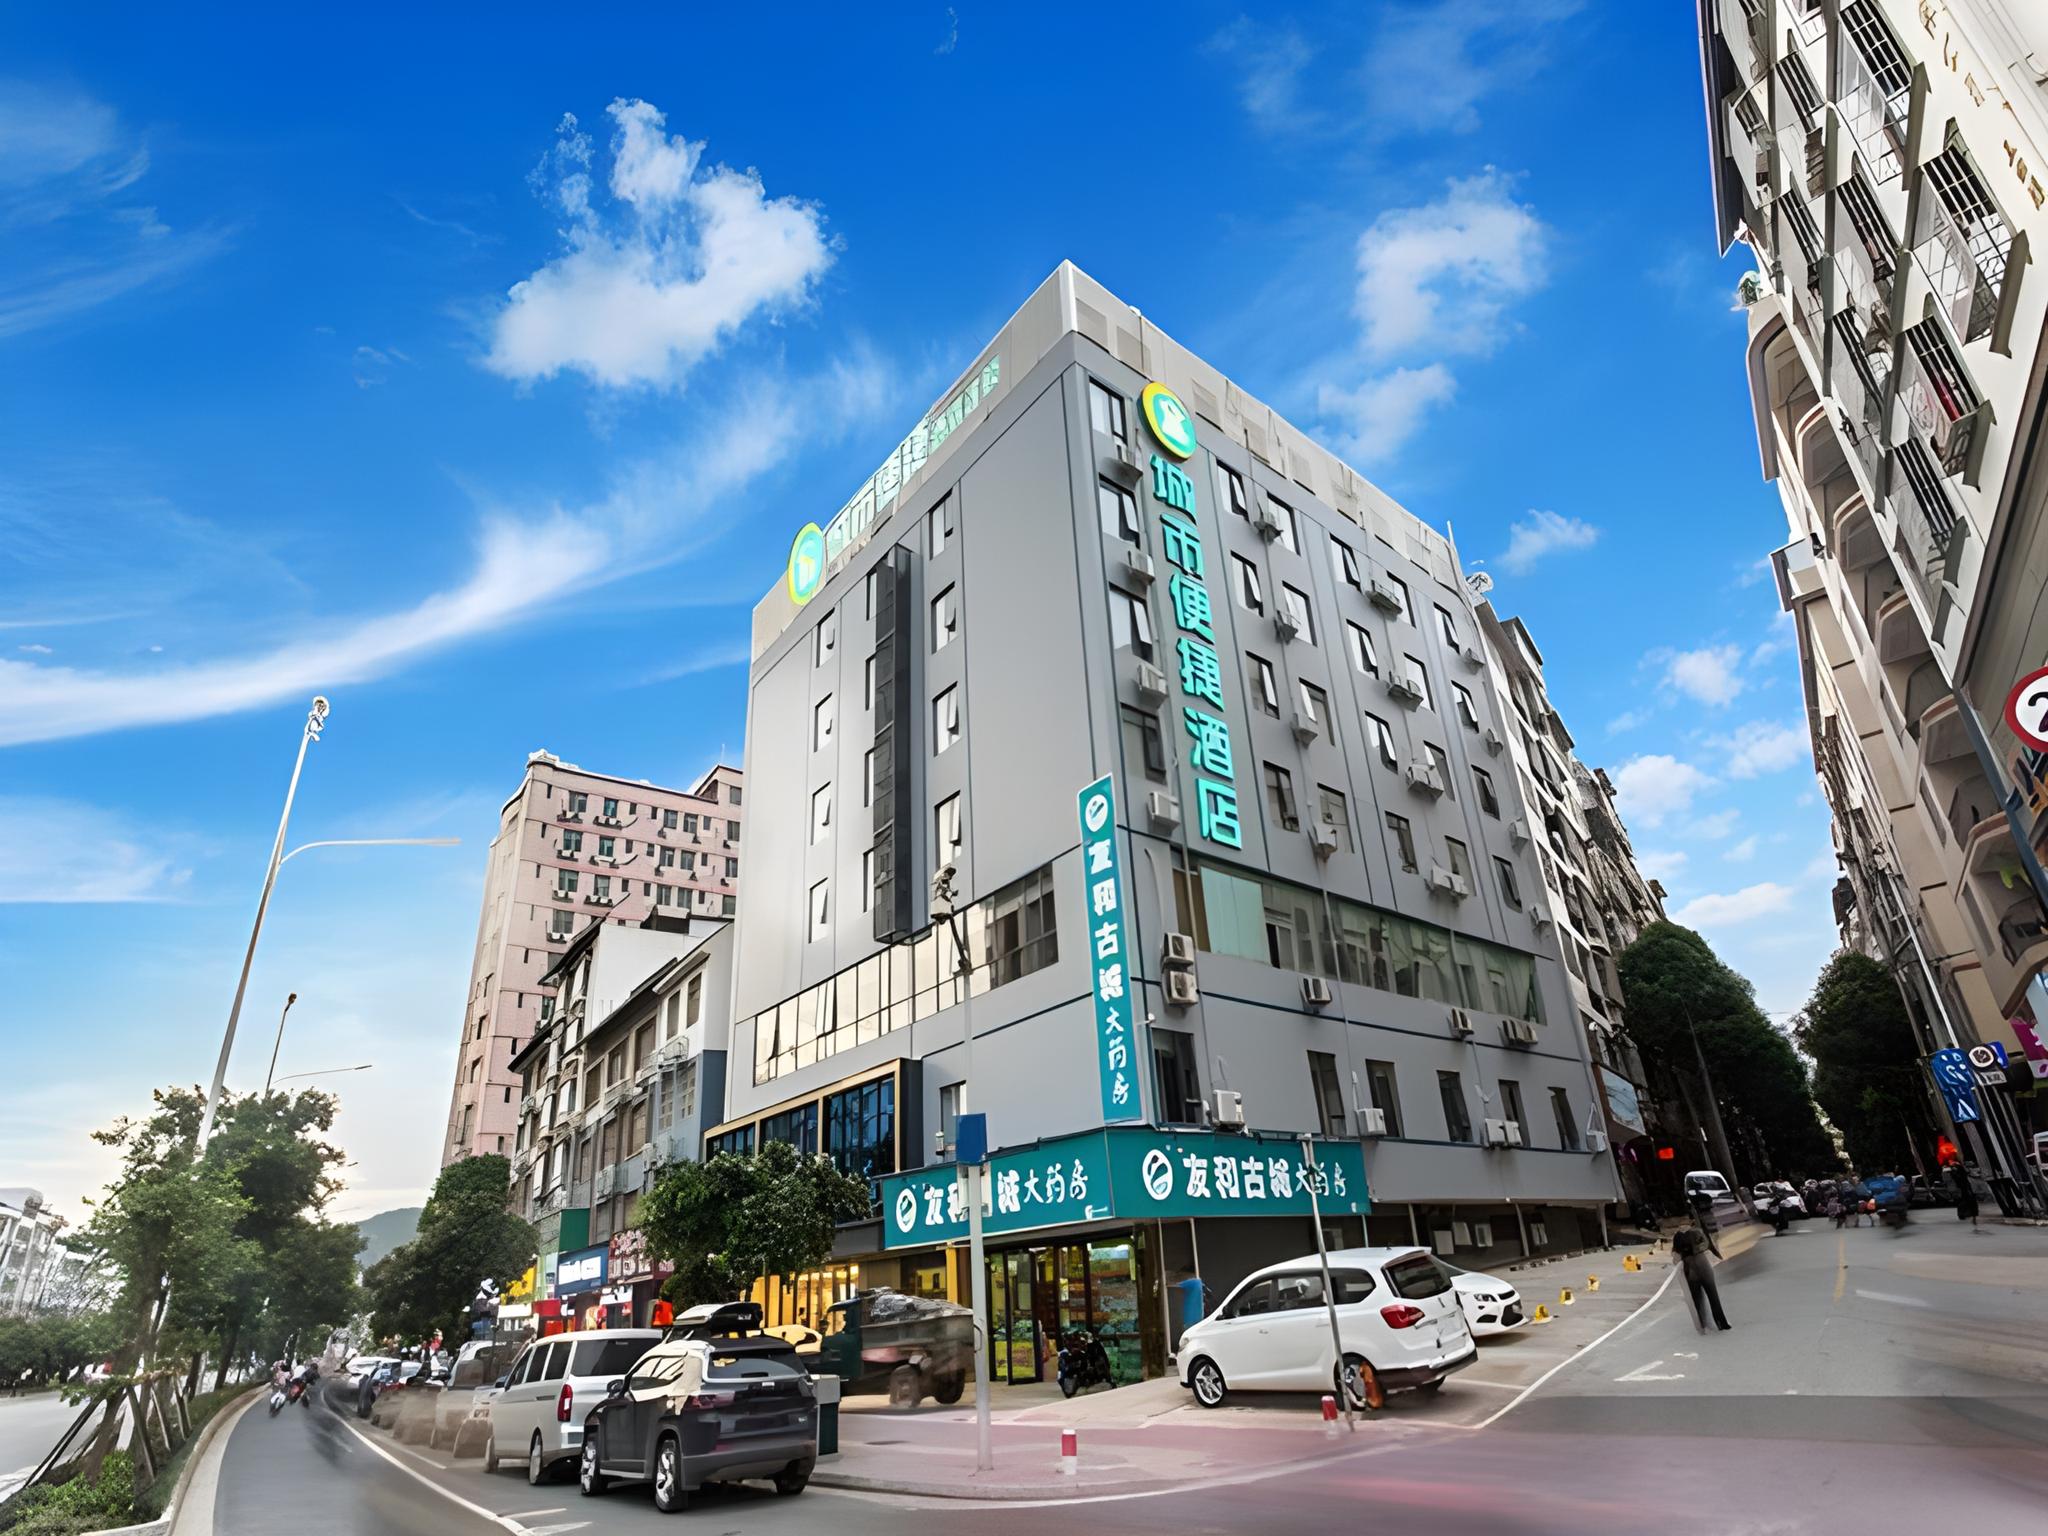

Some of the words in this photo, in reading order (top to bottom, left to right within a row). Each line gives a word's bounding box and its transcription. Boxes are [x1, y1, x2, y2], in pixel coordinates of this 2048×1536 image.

[1150, 453, 1242, 850] 城市便捷酒店
